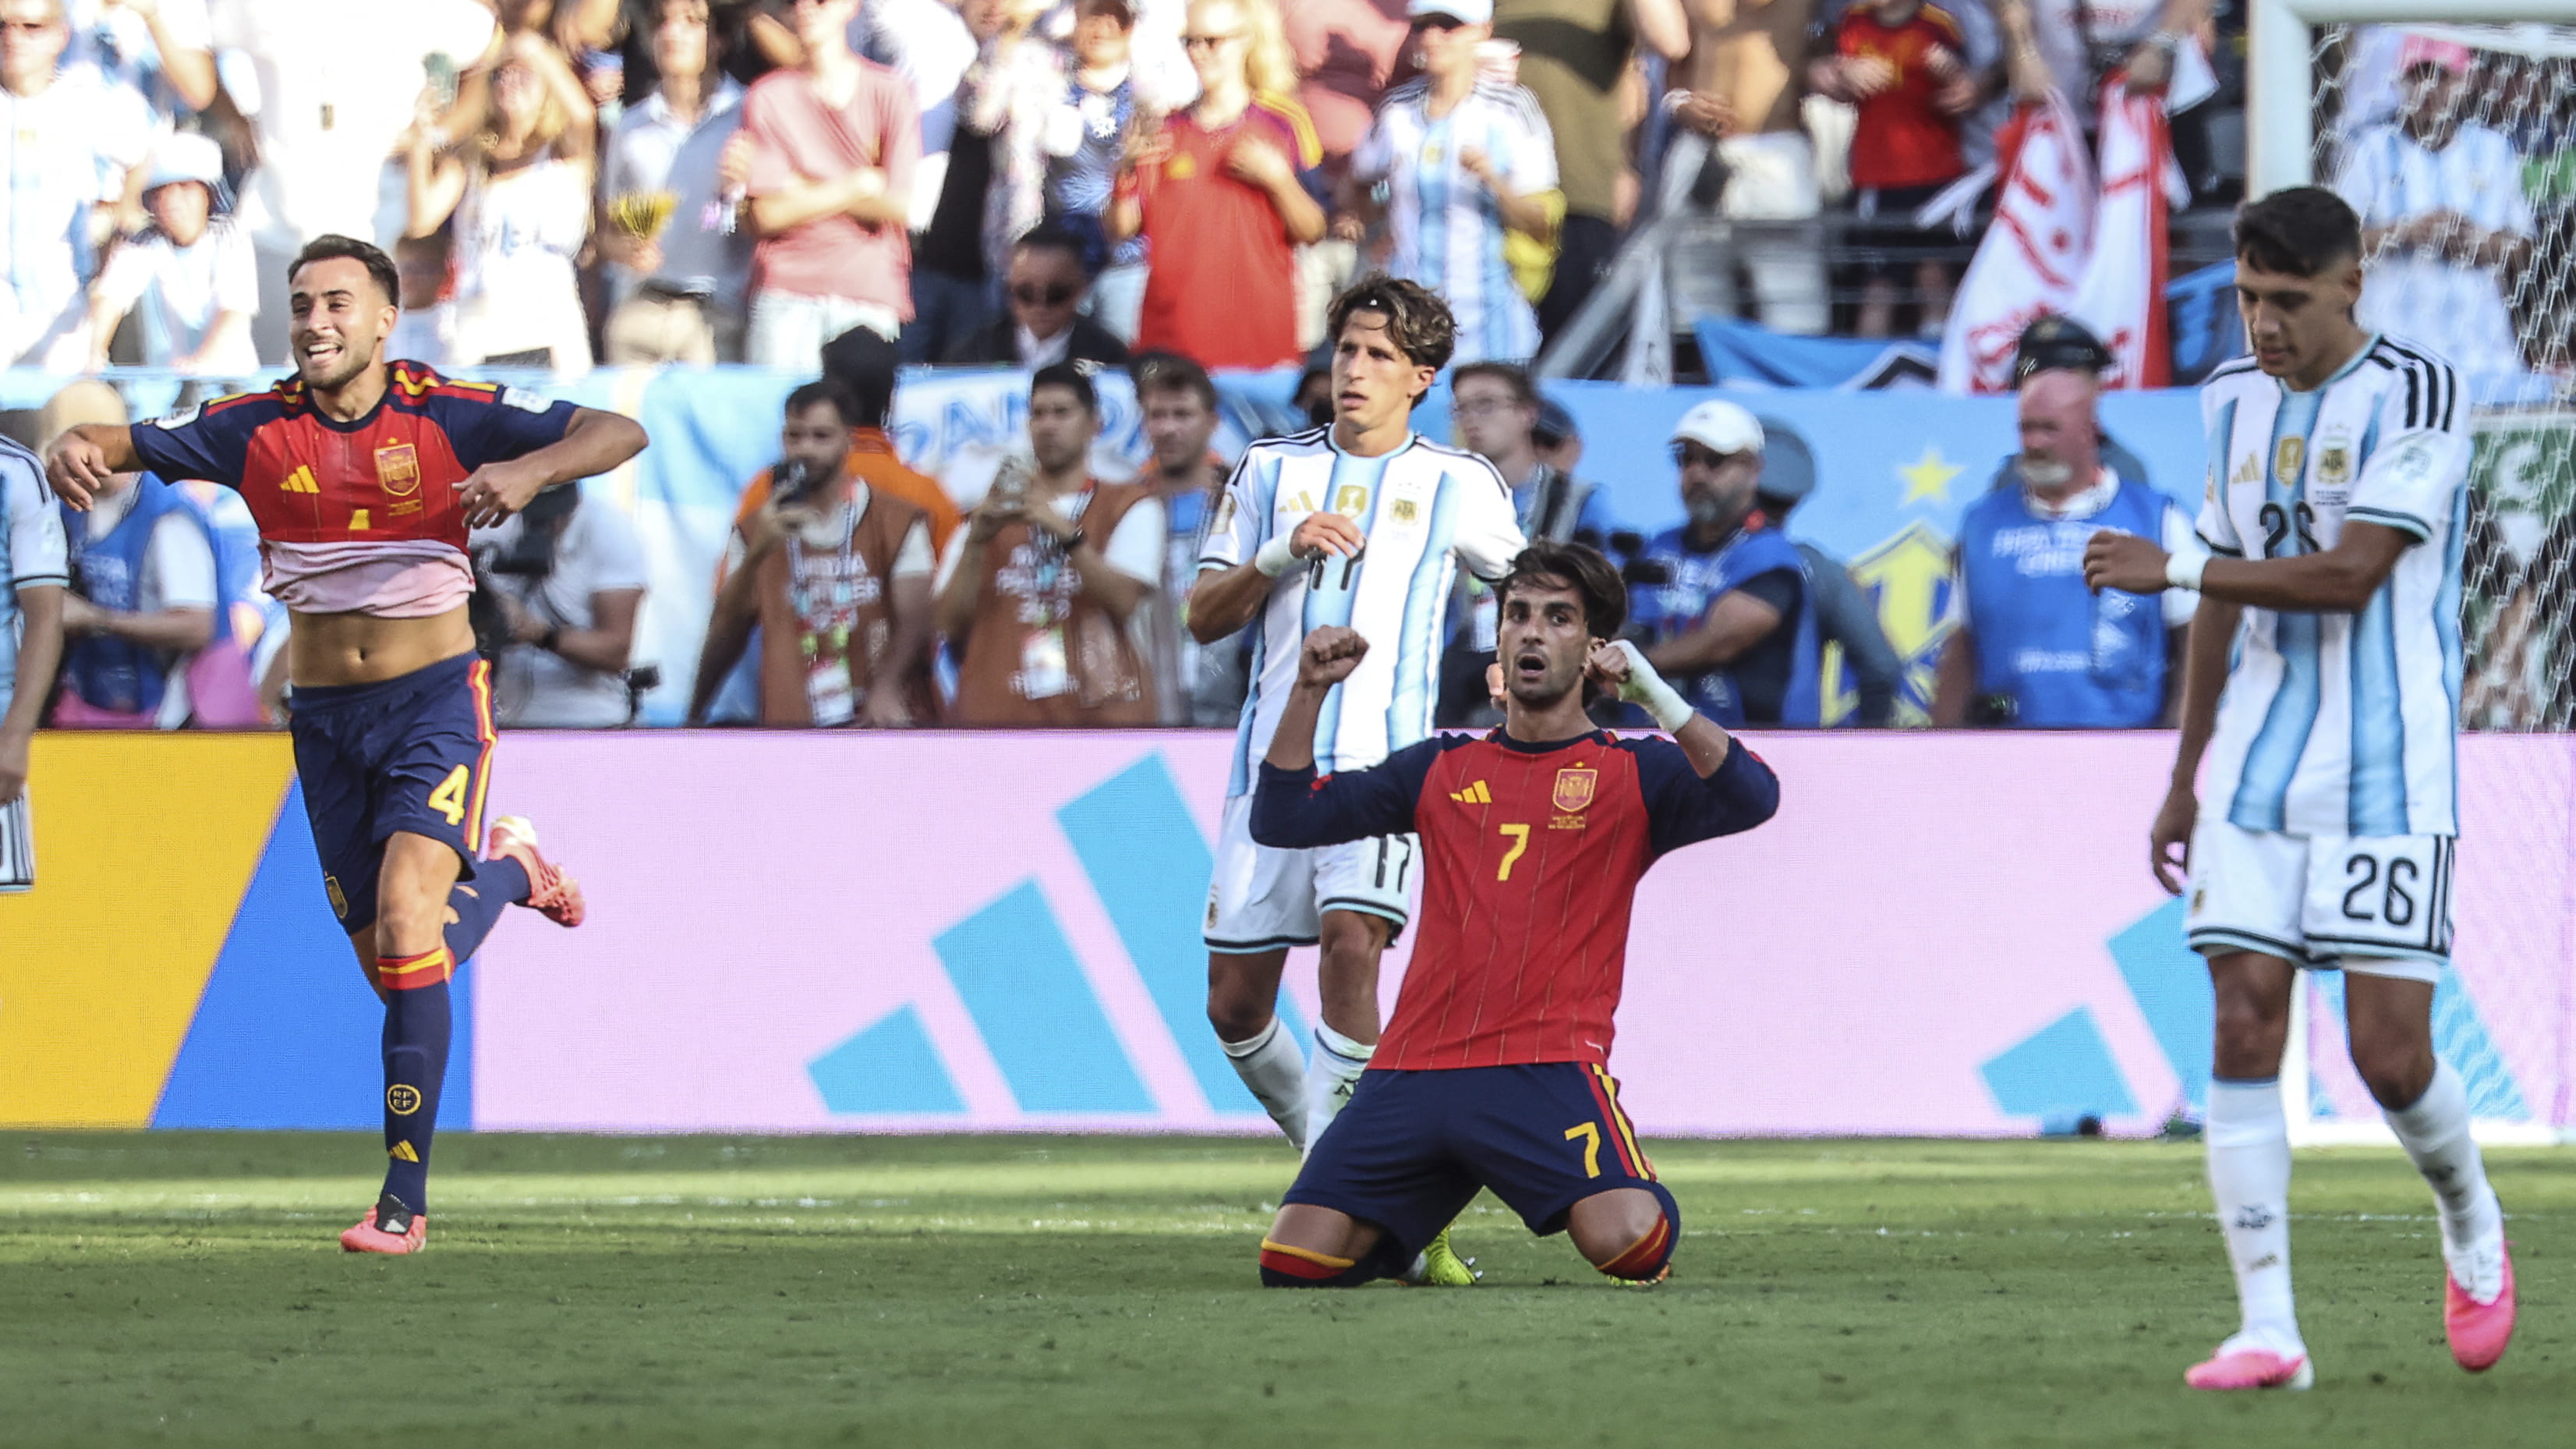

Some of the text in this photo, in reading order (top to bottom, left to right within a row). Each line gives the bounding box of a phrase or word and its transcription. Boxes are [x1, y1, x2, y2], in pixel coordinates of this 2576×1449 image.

[427, 763, 469, 826] 4
[1375, 834, 1410, 894] 17
[1497, 824, 1530, 880] 7
[2342, 853, 2418, 926] 26
[1564, 1121, 1601, 1178] 7
